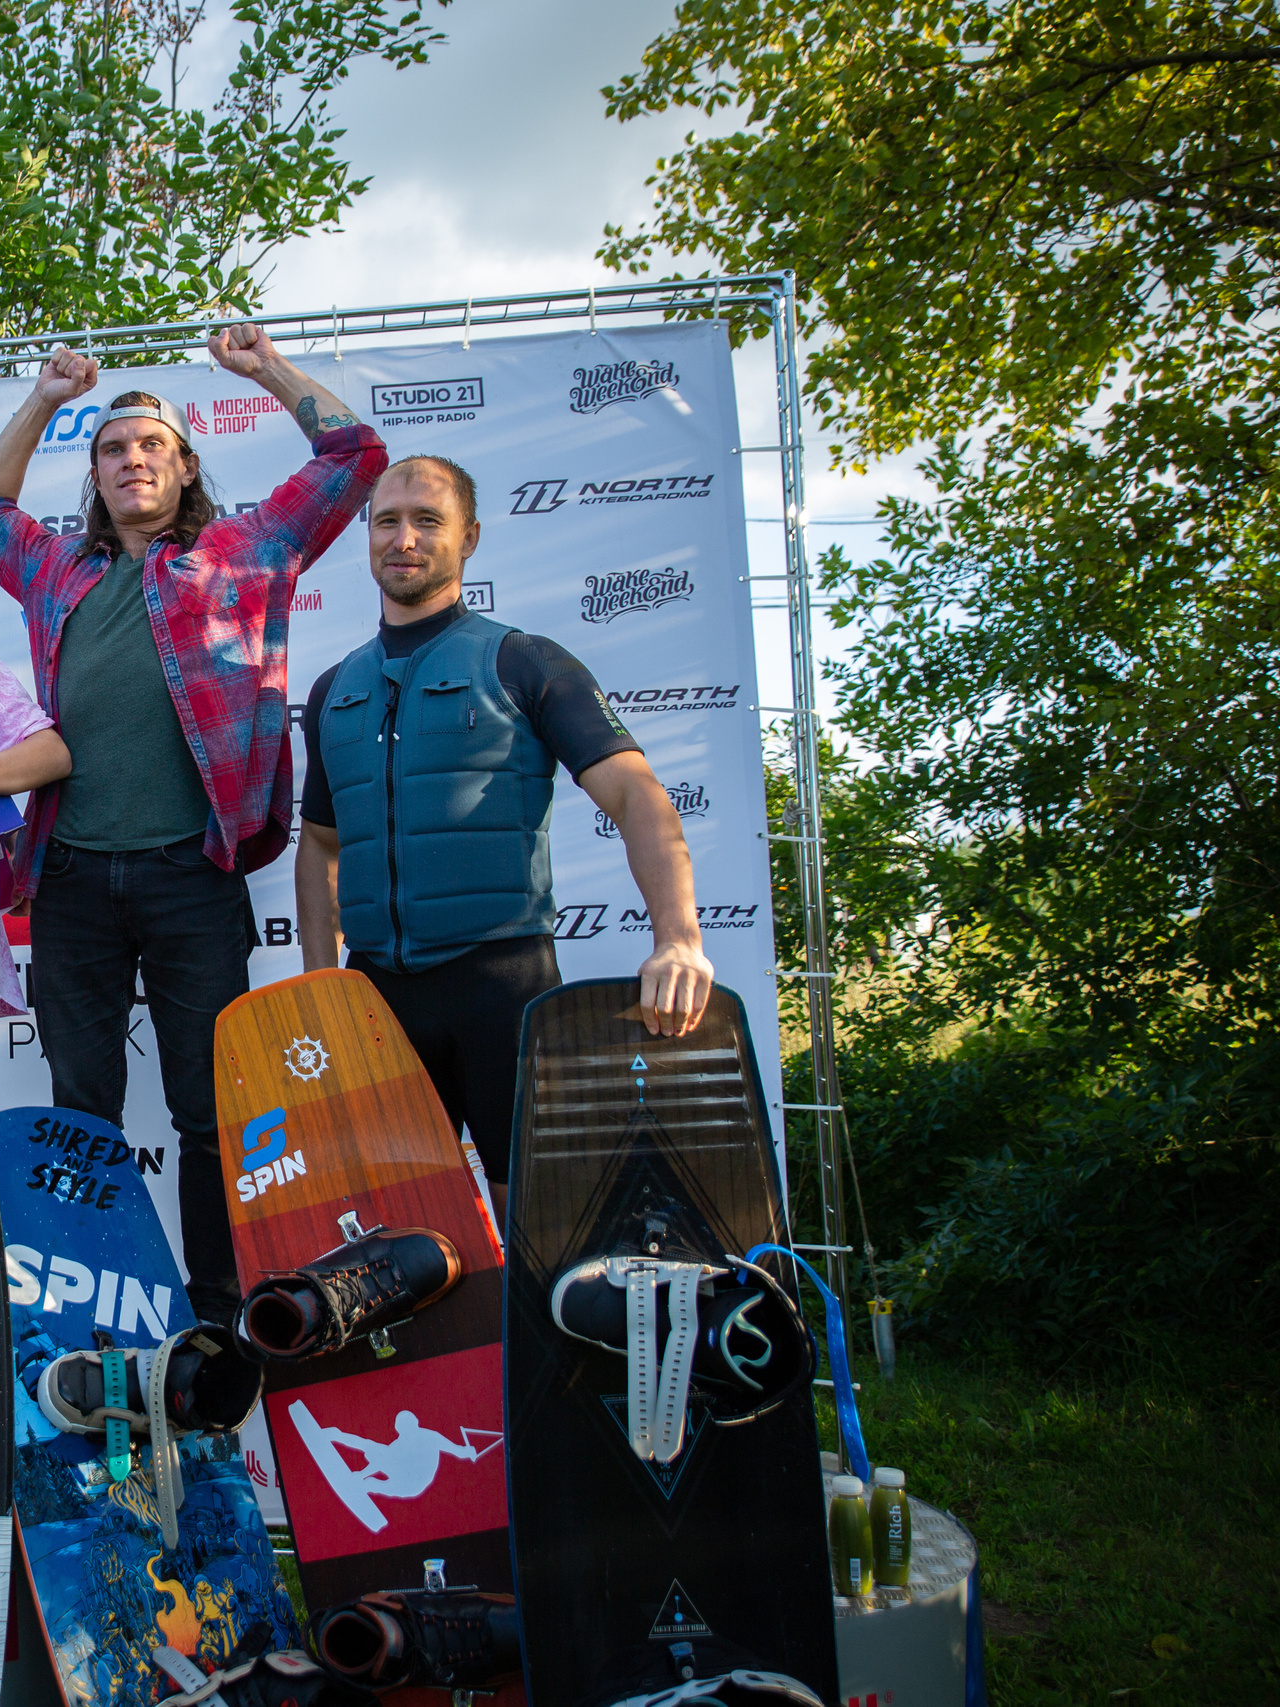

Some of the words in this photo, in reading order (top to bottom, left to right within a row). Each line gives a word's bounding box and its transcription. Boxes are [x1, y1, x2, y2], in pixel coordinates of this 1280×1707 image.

[213, 395, 288, 416] МОСКОВС
[381, 387, 451, 407] STUDIO
[456, 385, 476, 402] 21
[214, 415, 257, 435] СПОРТ
[382, 414, 434, 427] HIP-HOP
[436, 411, 476, 424] RADIO
[578, 474, 715, 496] NORTH
[579, 489, 711, 505] KITEBOARDING
[466, 588, 485, 606] 21
[605, 685, 741, 703] NORTH
[28, 1117, 132, 1166] SHRED
[62, 1156, 95, 1174] AND
[27, 1162, 122, 1210] STYLE
[235, 1149, 308, 1203] SPIN
[4, 1244, 172, 1341] SPIN
[888, 1504, 902, 1540] Rich
